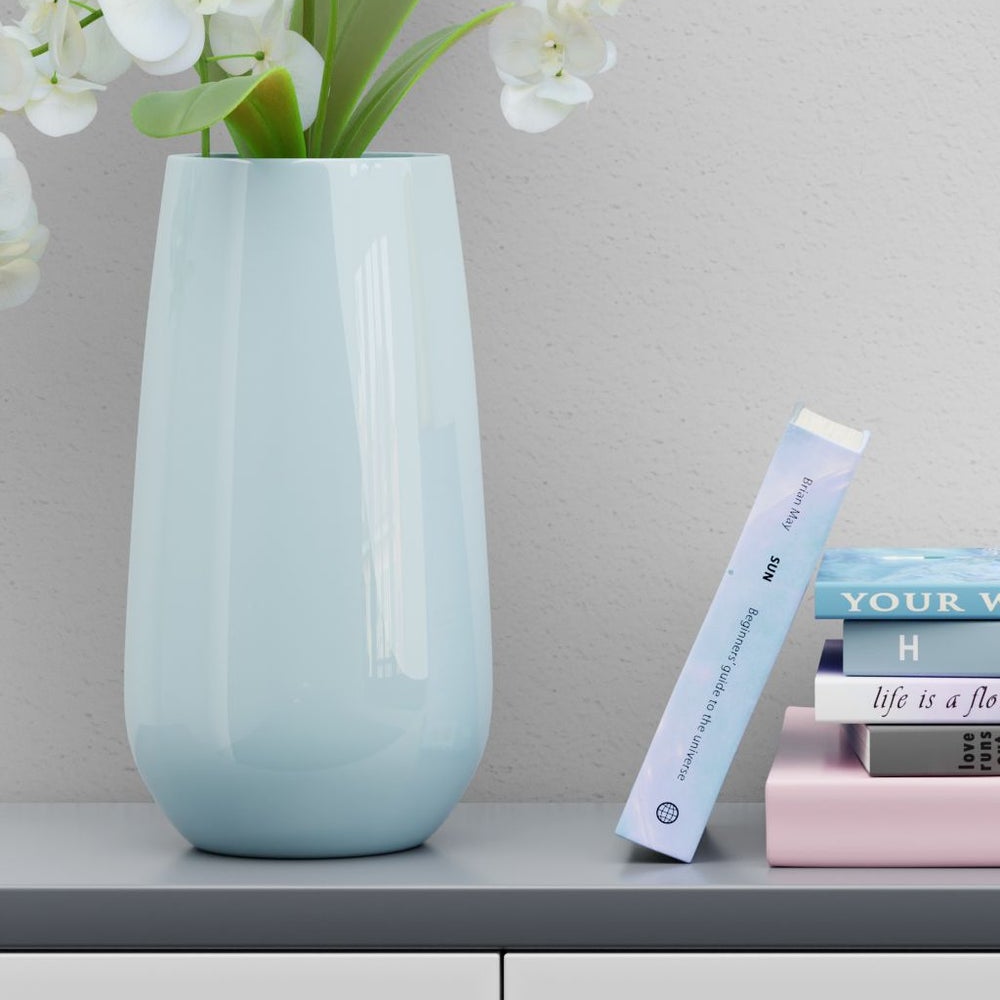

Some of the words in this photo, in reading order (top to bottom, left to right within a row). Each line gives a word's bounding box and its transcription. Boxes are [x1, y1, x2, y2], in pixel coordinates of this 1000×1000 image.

[794, 476, 814, 506] Brian
[781, 507, 800, 532] May
[762, 555, 781, 582] SUN
[843, 592, 966, 613] YOUR
[712, 664, 732, 697] guide
[706, 699, 719, 712] to
[873, 685, 908, 717] life
[918, 690, 936, 709] is
[945, 694, 961, 709] a
[699, 714, 712, 733] the
[677, 734, 702, 782] universe
[958, 732, 975, 770] love
[980, 731, 992, 771] runs
